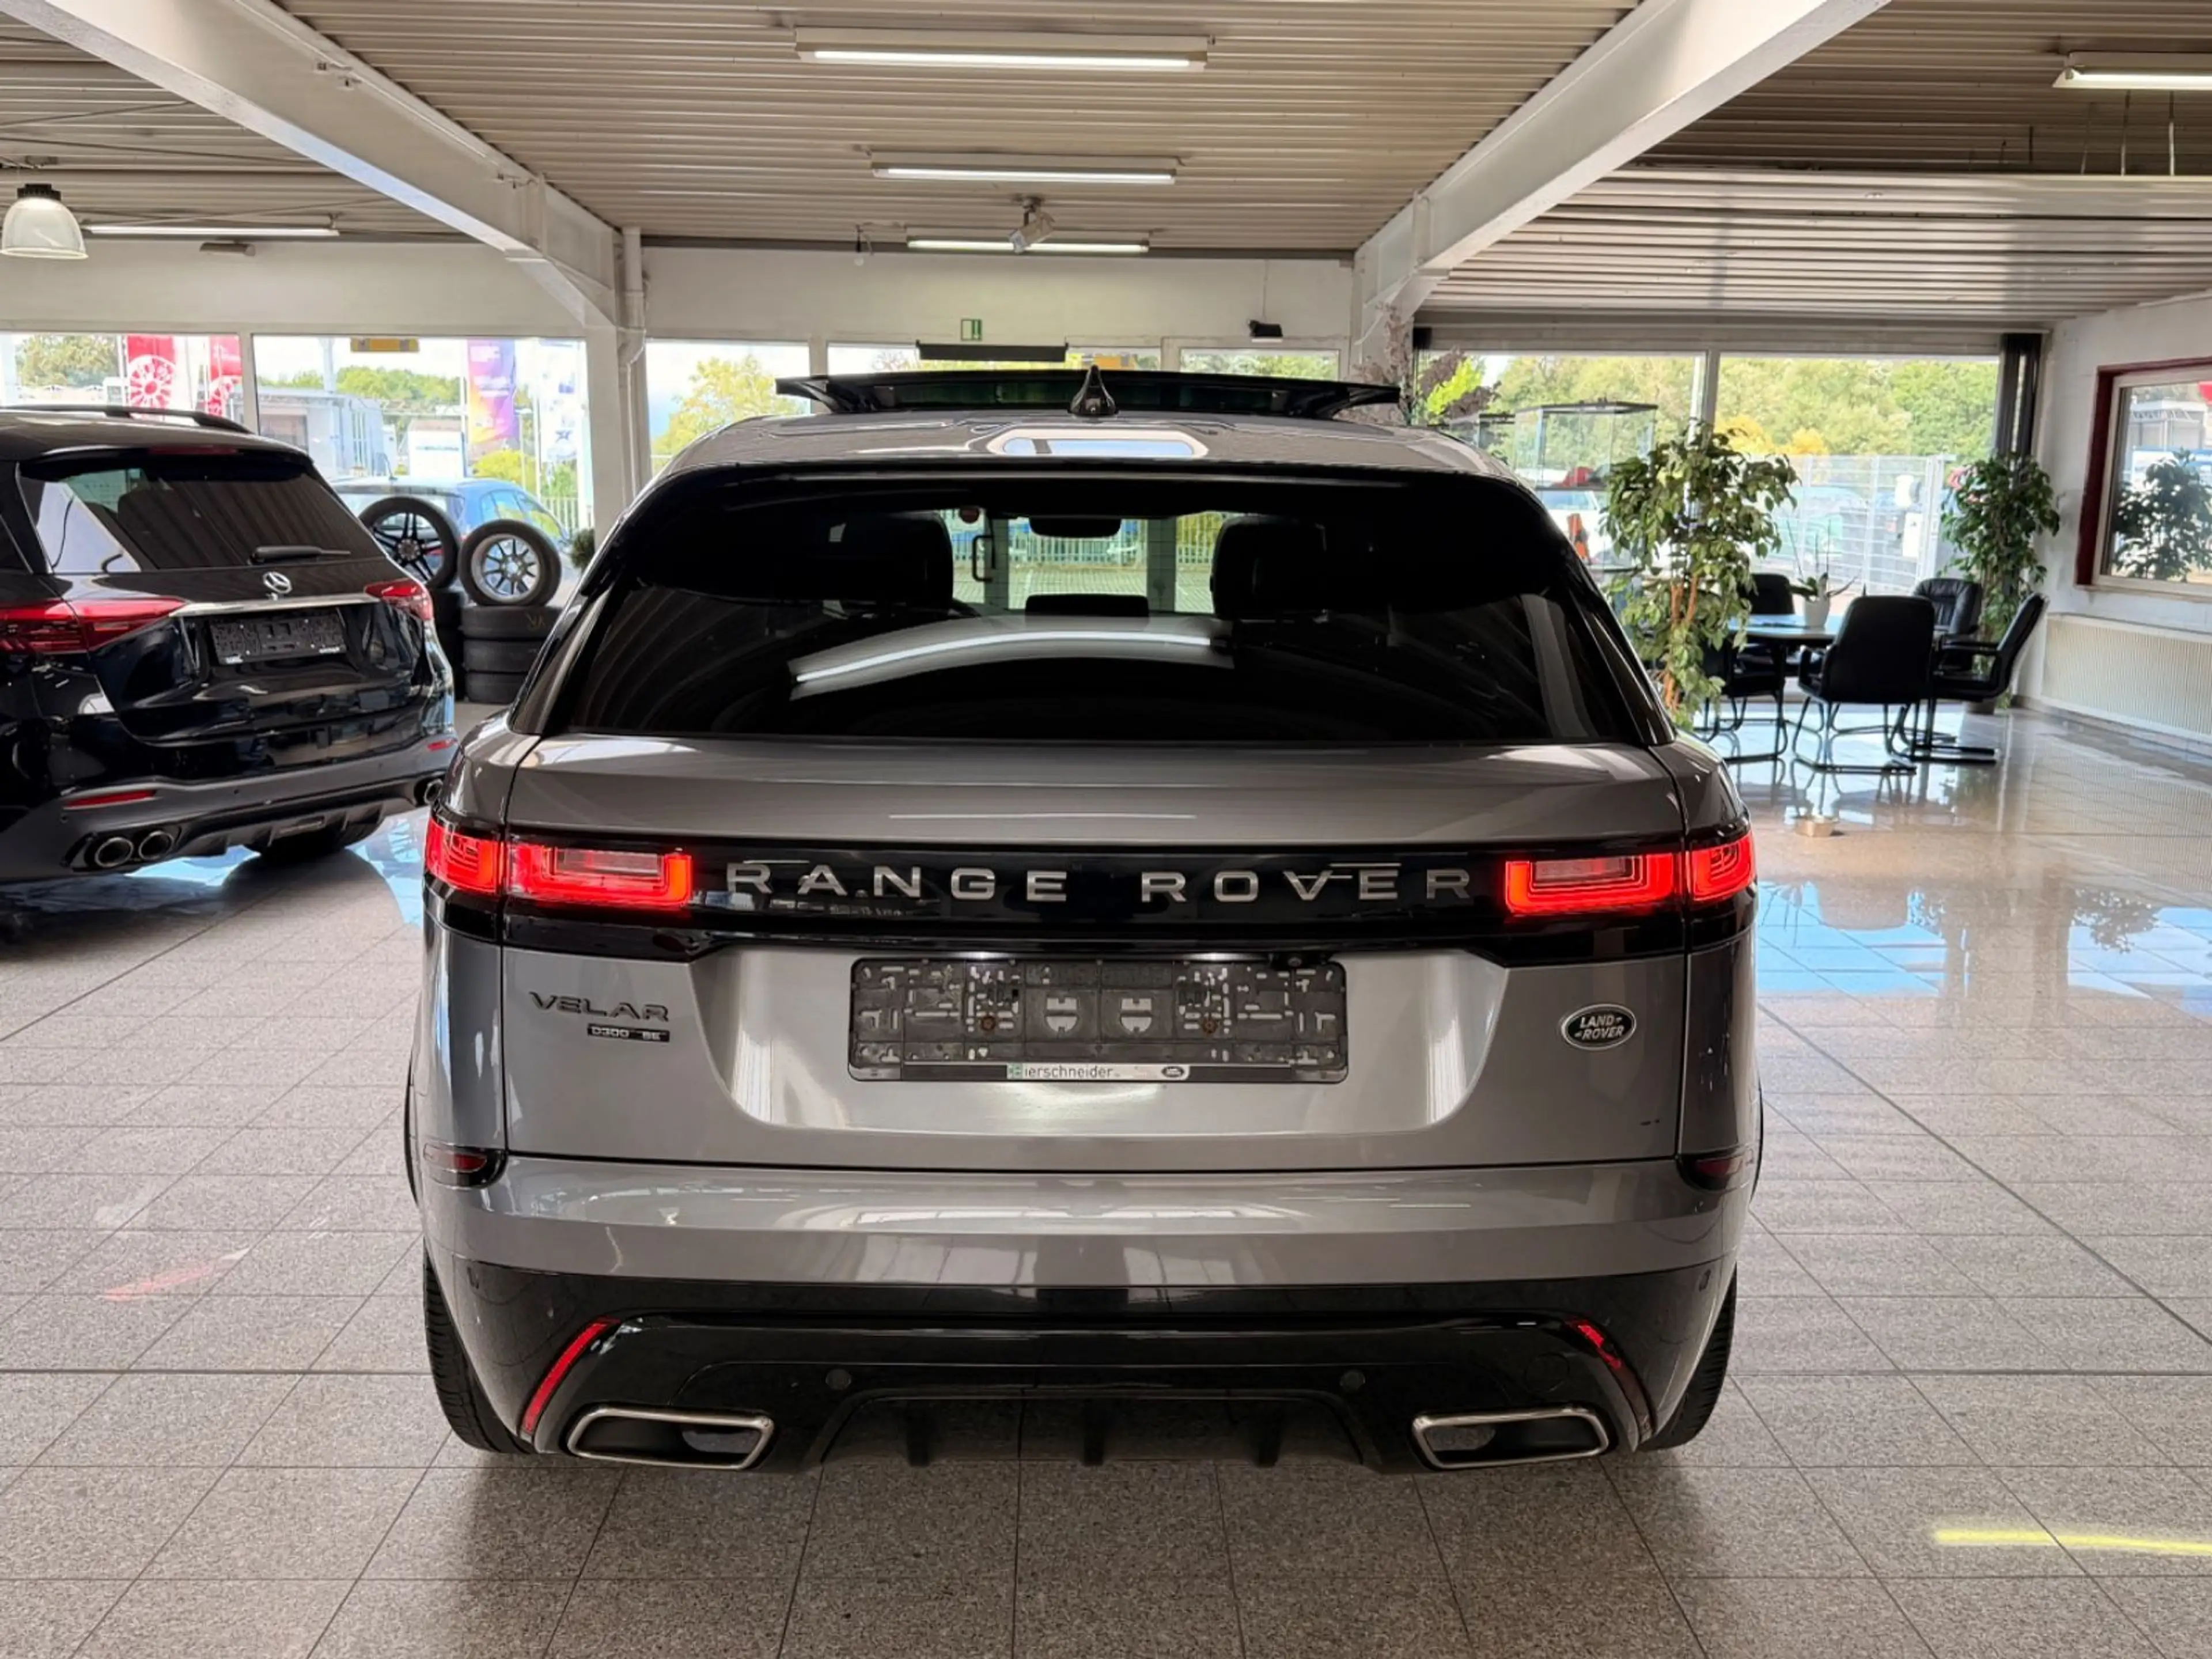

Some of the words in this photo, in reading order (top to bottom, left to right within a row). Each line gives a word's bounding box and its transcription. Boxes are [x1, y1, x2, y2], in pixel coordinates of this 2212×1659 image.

[726, 863, 1067, 903] RANGE
[1141, 869, 1471, 903] ROVER
[528, 991, 669, 1022] VELAR
